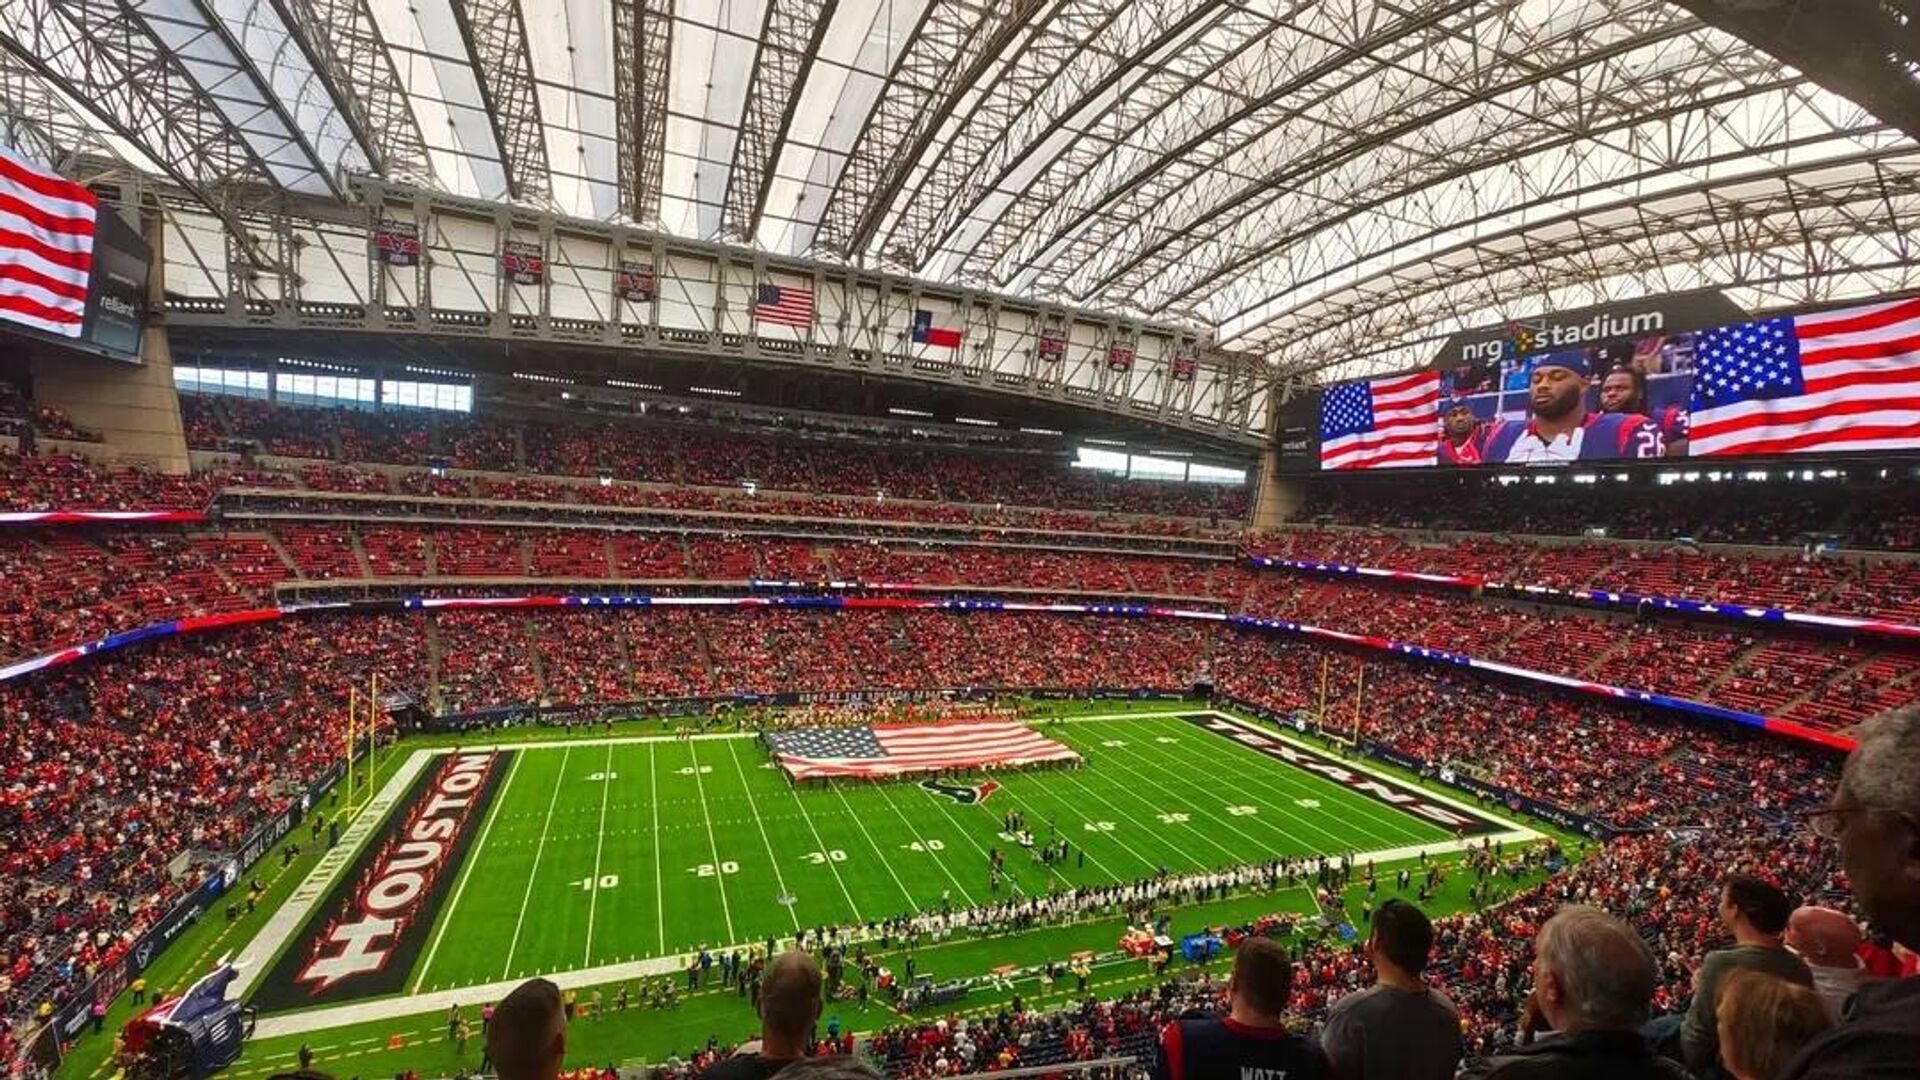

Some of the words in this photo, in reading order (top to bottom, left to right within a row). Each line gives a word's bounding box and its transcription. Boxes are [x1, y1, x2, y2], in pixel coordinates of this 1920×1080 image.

[1462, 340, 1503, 367] nrg
[1534, 311, 1665, 348] stadium
[1206, 718, 1479, 826] TEXANS
[909, 839, 945, 852] 40
[808, 850, 848, 864] 30
[301, 754, 491, 988] HOUSTON
[697, 860, 740, 877] 20
[582, 874, 619, 890] 10
[1241, 1067, 1287, 1080] WATT
